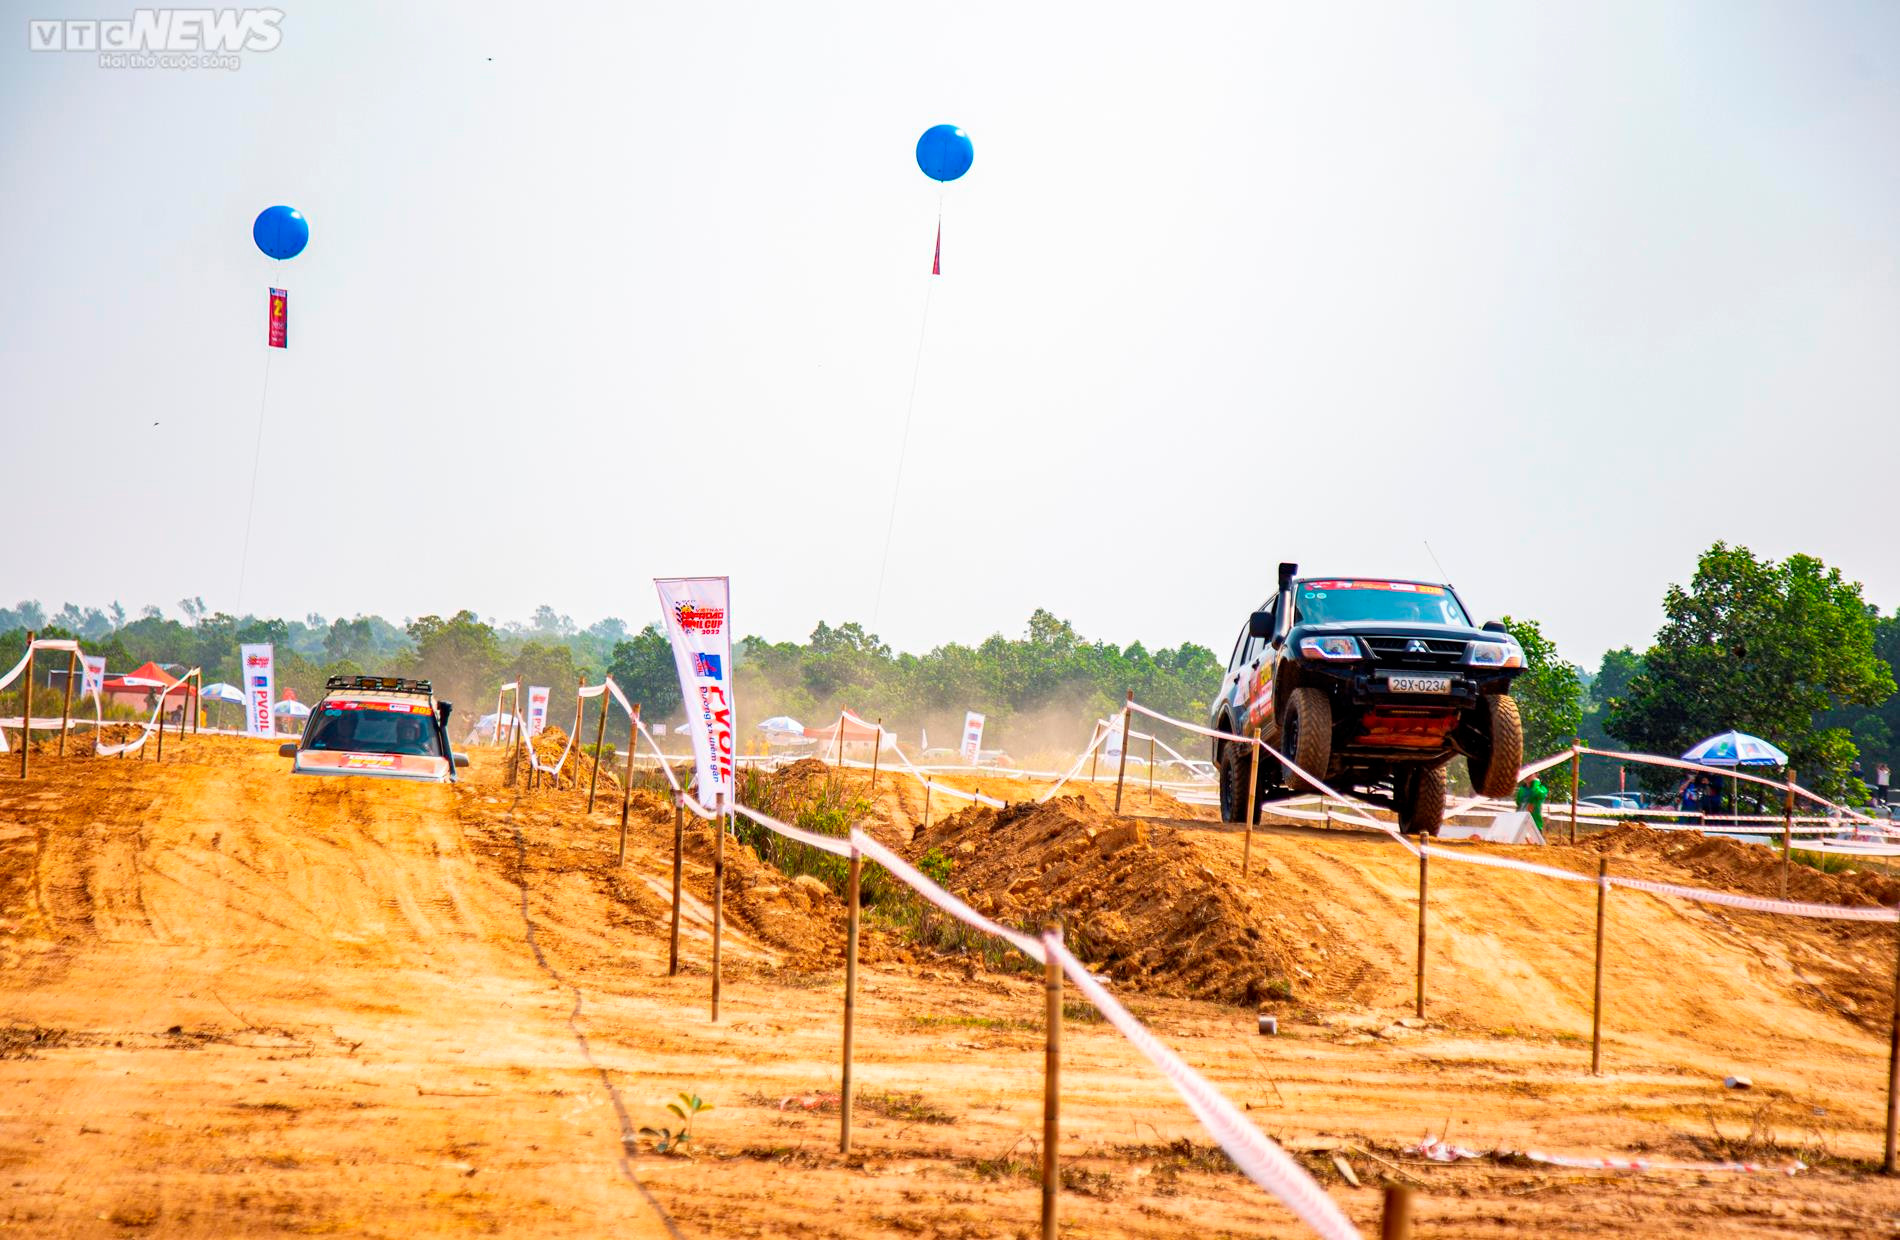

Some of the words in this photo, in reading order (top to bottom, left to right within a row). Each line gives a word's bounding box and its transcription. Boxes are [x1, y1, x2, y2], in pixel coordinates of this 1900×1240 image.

[704, 619, 723, 629] CUP
[1392, 678, 1446, 693] 29X-0234
[256, 690, 270, 732] PVOIL
[412, 706, 433, 716] 205
